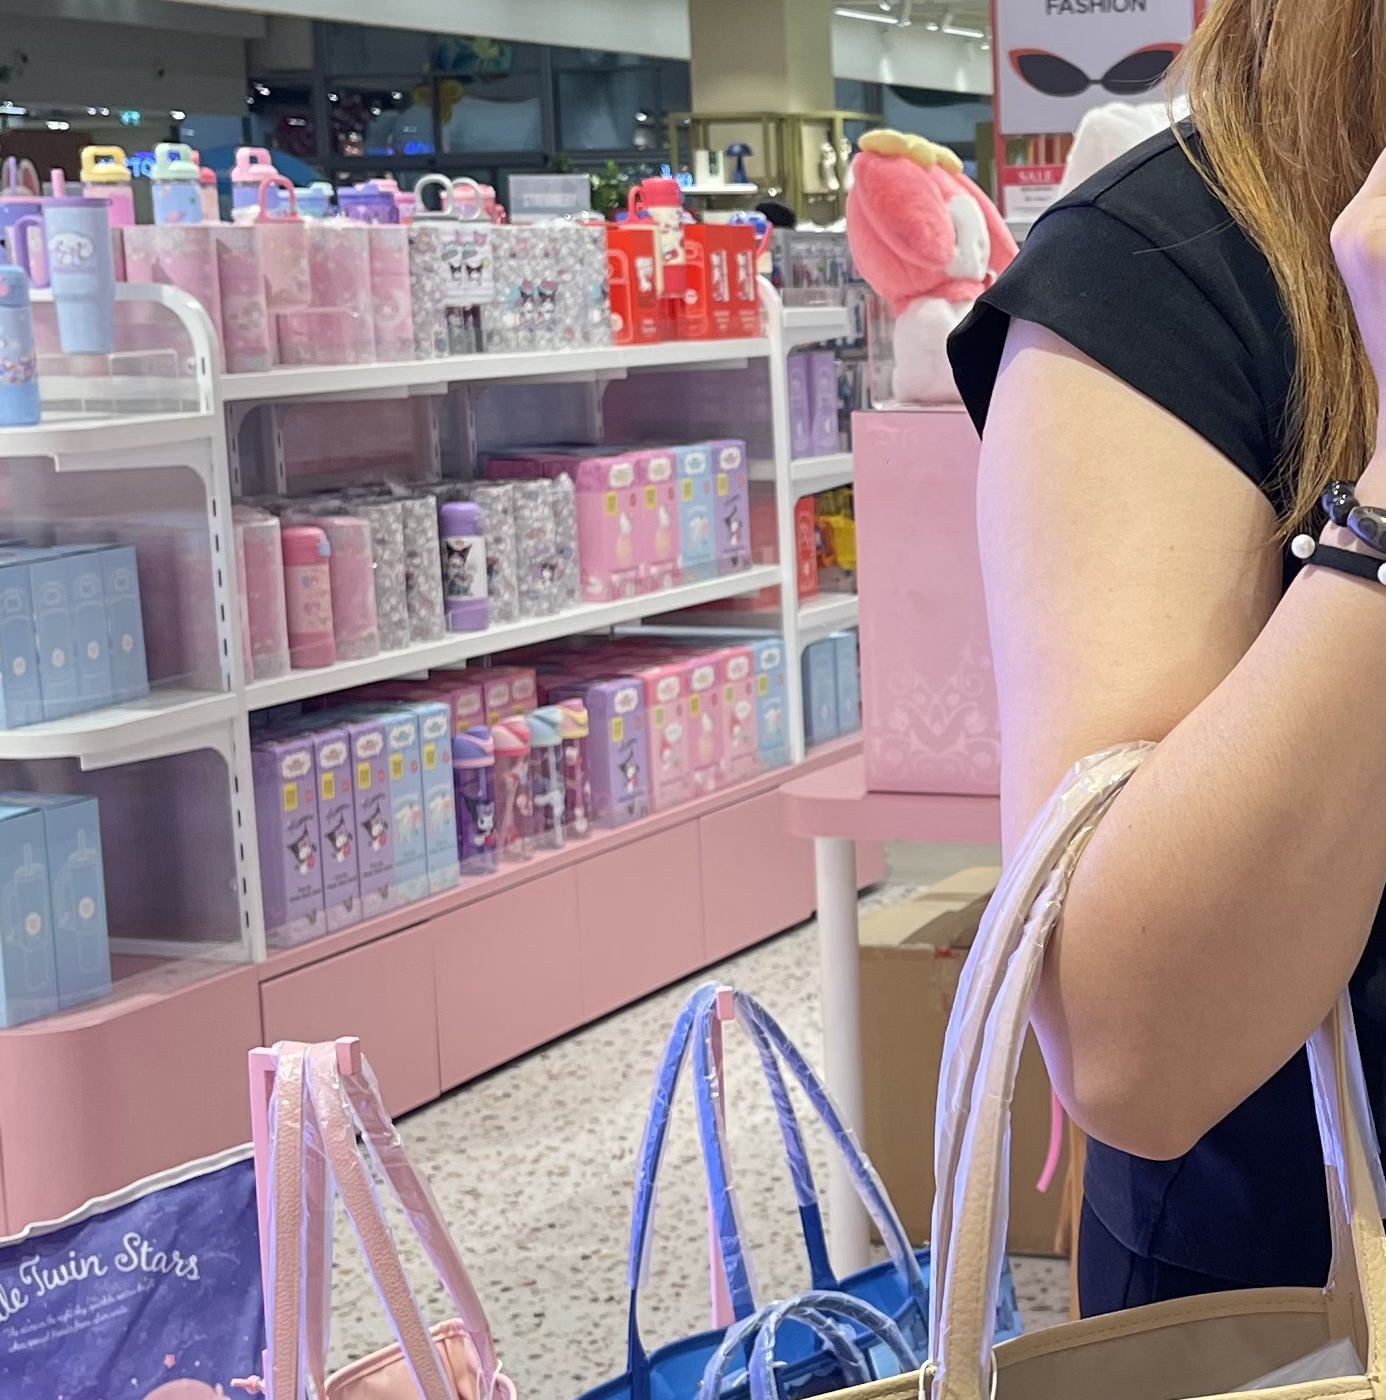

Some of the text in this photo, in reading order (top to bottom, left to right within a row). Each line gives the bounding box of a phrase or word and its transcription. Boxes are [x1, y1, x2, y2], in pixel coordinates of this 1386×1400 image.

[1045, 0, 1147, 15] FASHION
[19, 1250, 109, 1297] Twin
[114, 1232, 201, 1281] Stars
